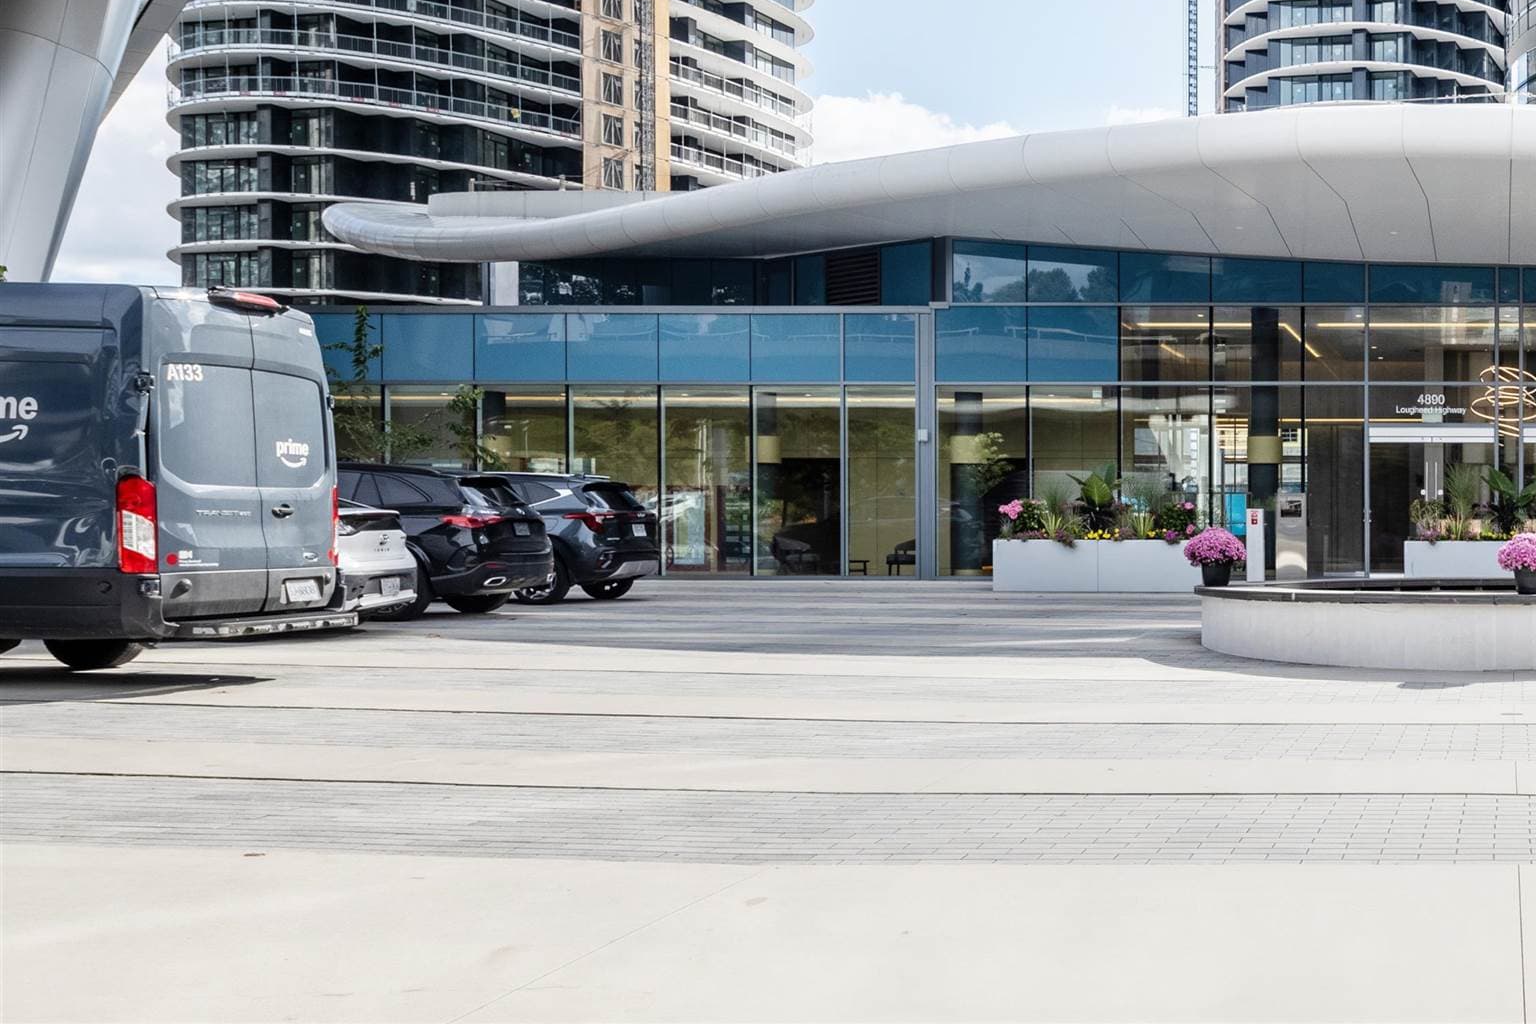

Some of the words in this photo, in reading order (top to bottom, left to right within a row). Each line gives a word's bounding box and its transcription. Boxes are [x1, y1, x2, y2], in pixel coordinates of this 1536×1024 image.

[167, 364, 204, 381] A133
[1417, 394, 1446, 405] 4890
[1395, 406, 1433, 415] Lougheed
[1435, 406, 1467, 415] Highway
[276, 438, 309, 457] prime
